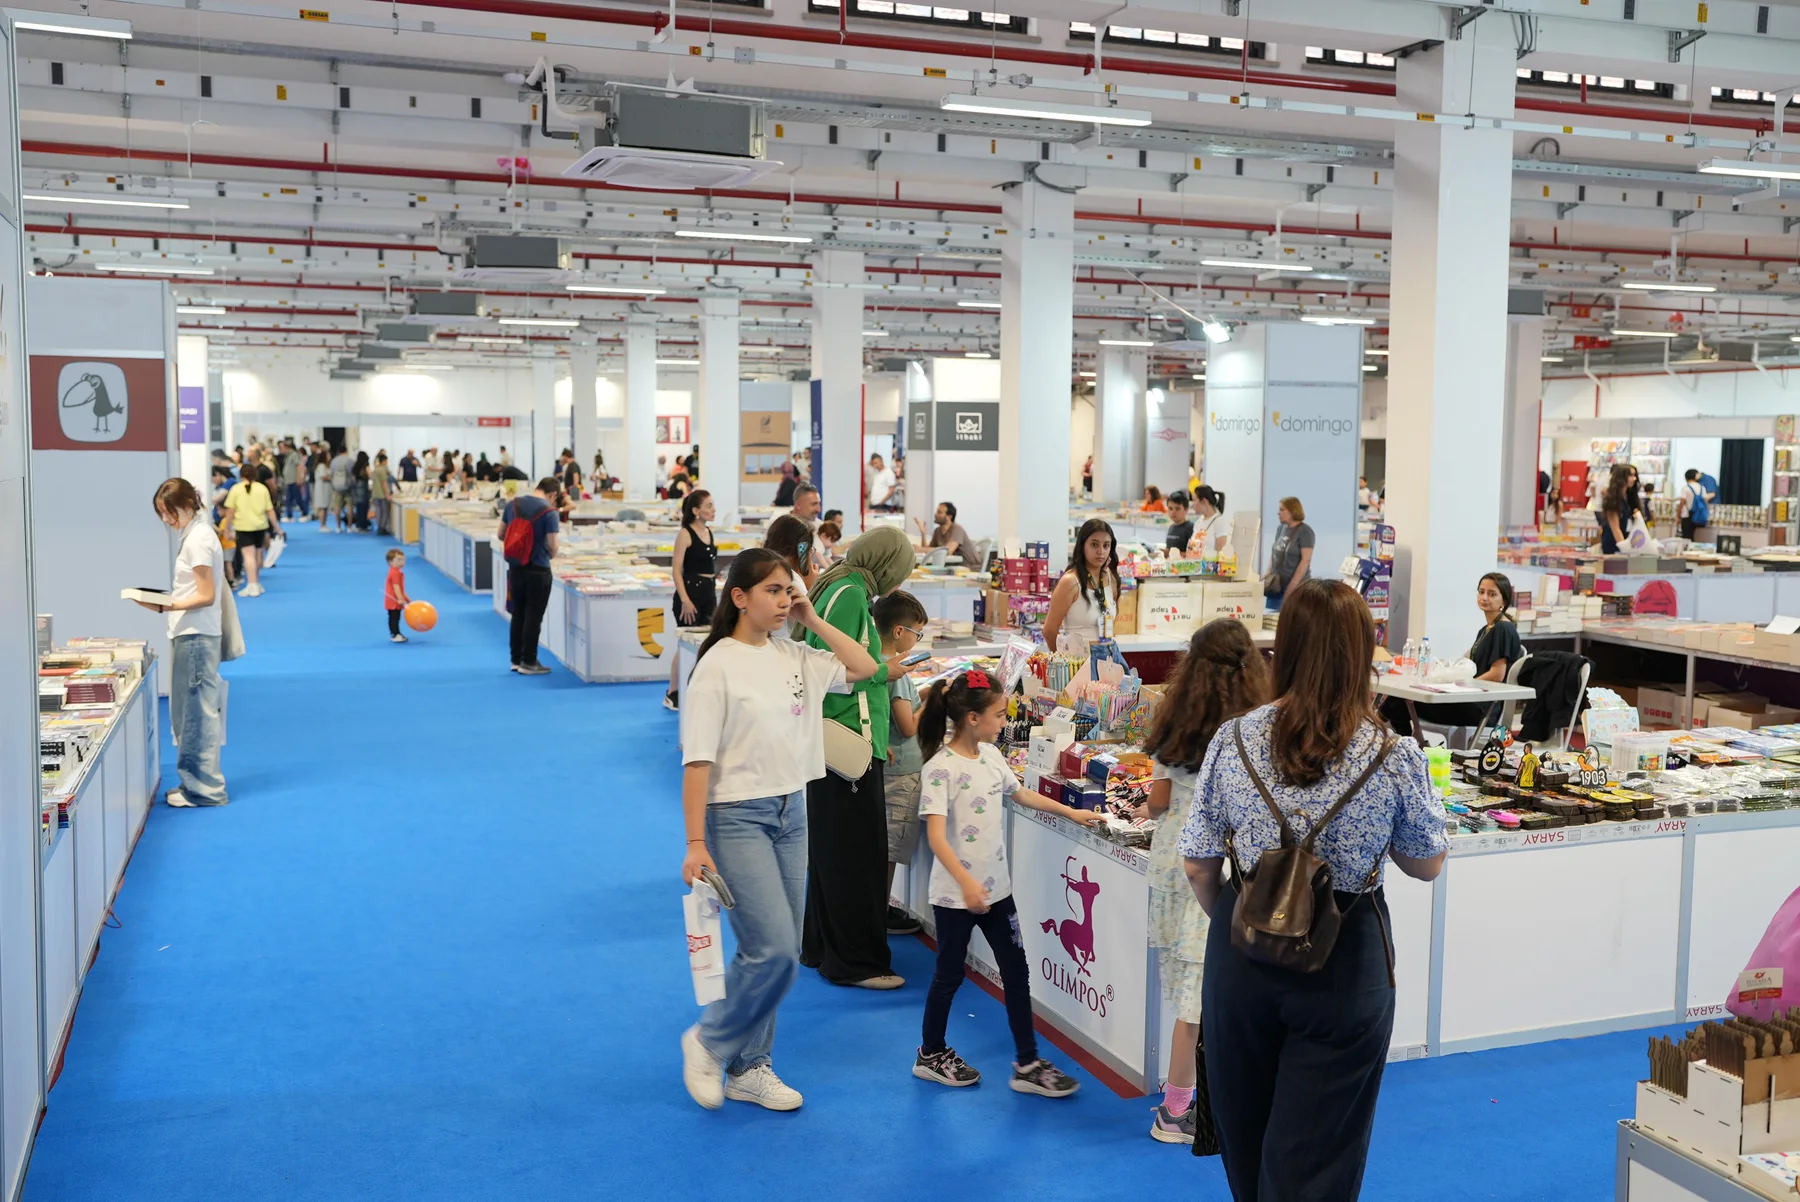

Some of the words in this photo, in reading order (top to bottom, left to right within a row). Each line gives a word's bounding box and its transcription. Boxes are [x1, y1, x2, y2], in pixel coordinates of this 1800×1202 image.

[1216, 416, 1260, 435] domingo
[1281, 415, 1353, 436] domingo
[1580, 770, 1607, 786] 1903
[1034, 808, 1057, 828] SARAY
[1656, 820, 1687, 834] ARAY
[1522, 830, 1565, 846] SARAY
[1110, 845, 1137, 867] SARAY
[1686, 1005, 1723, 1018] SARAY
